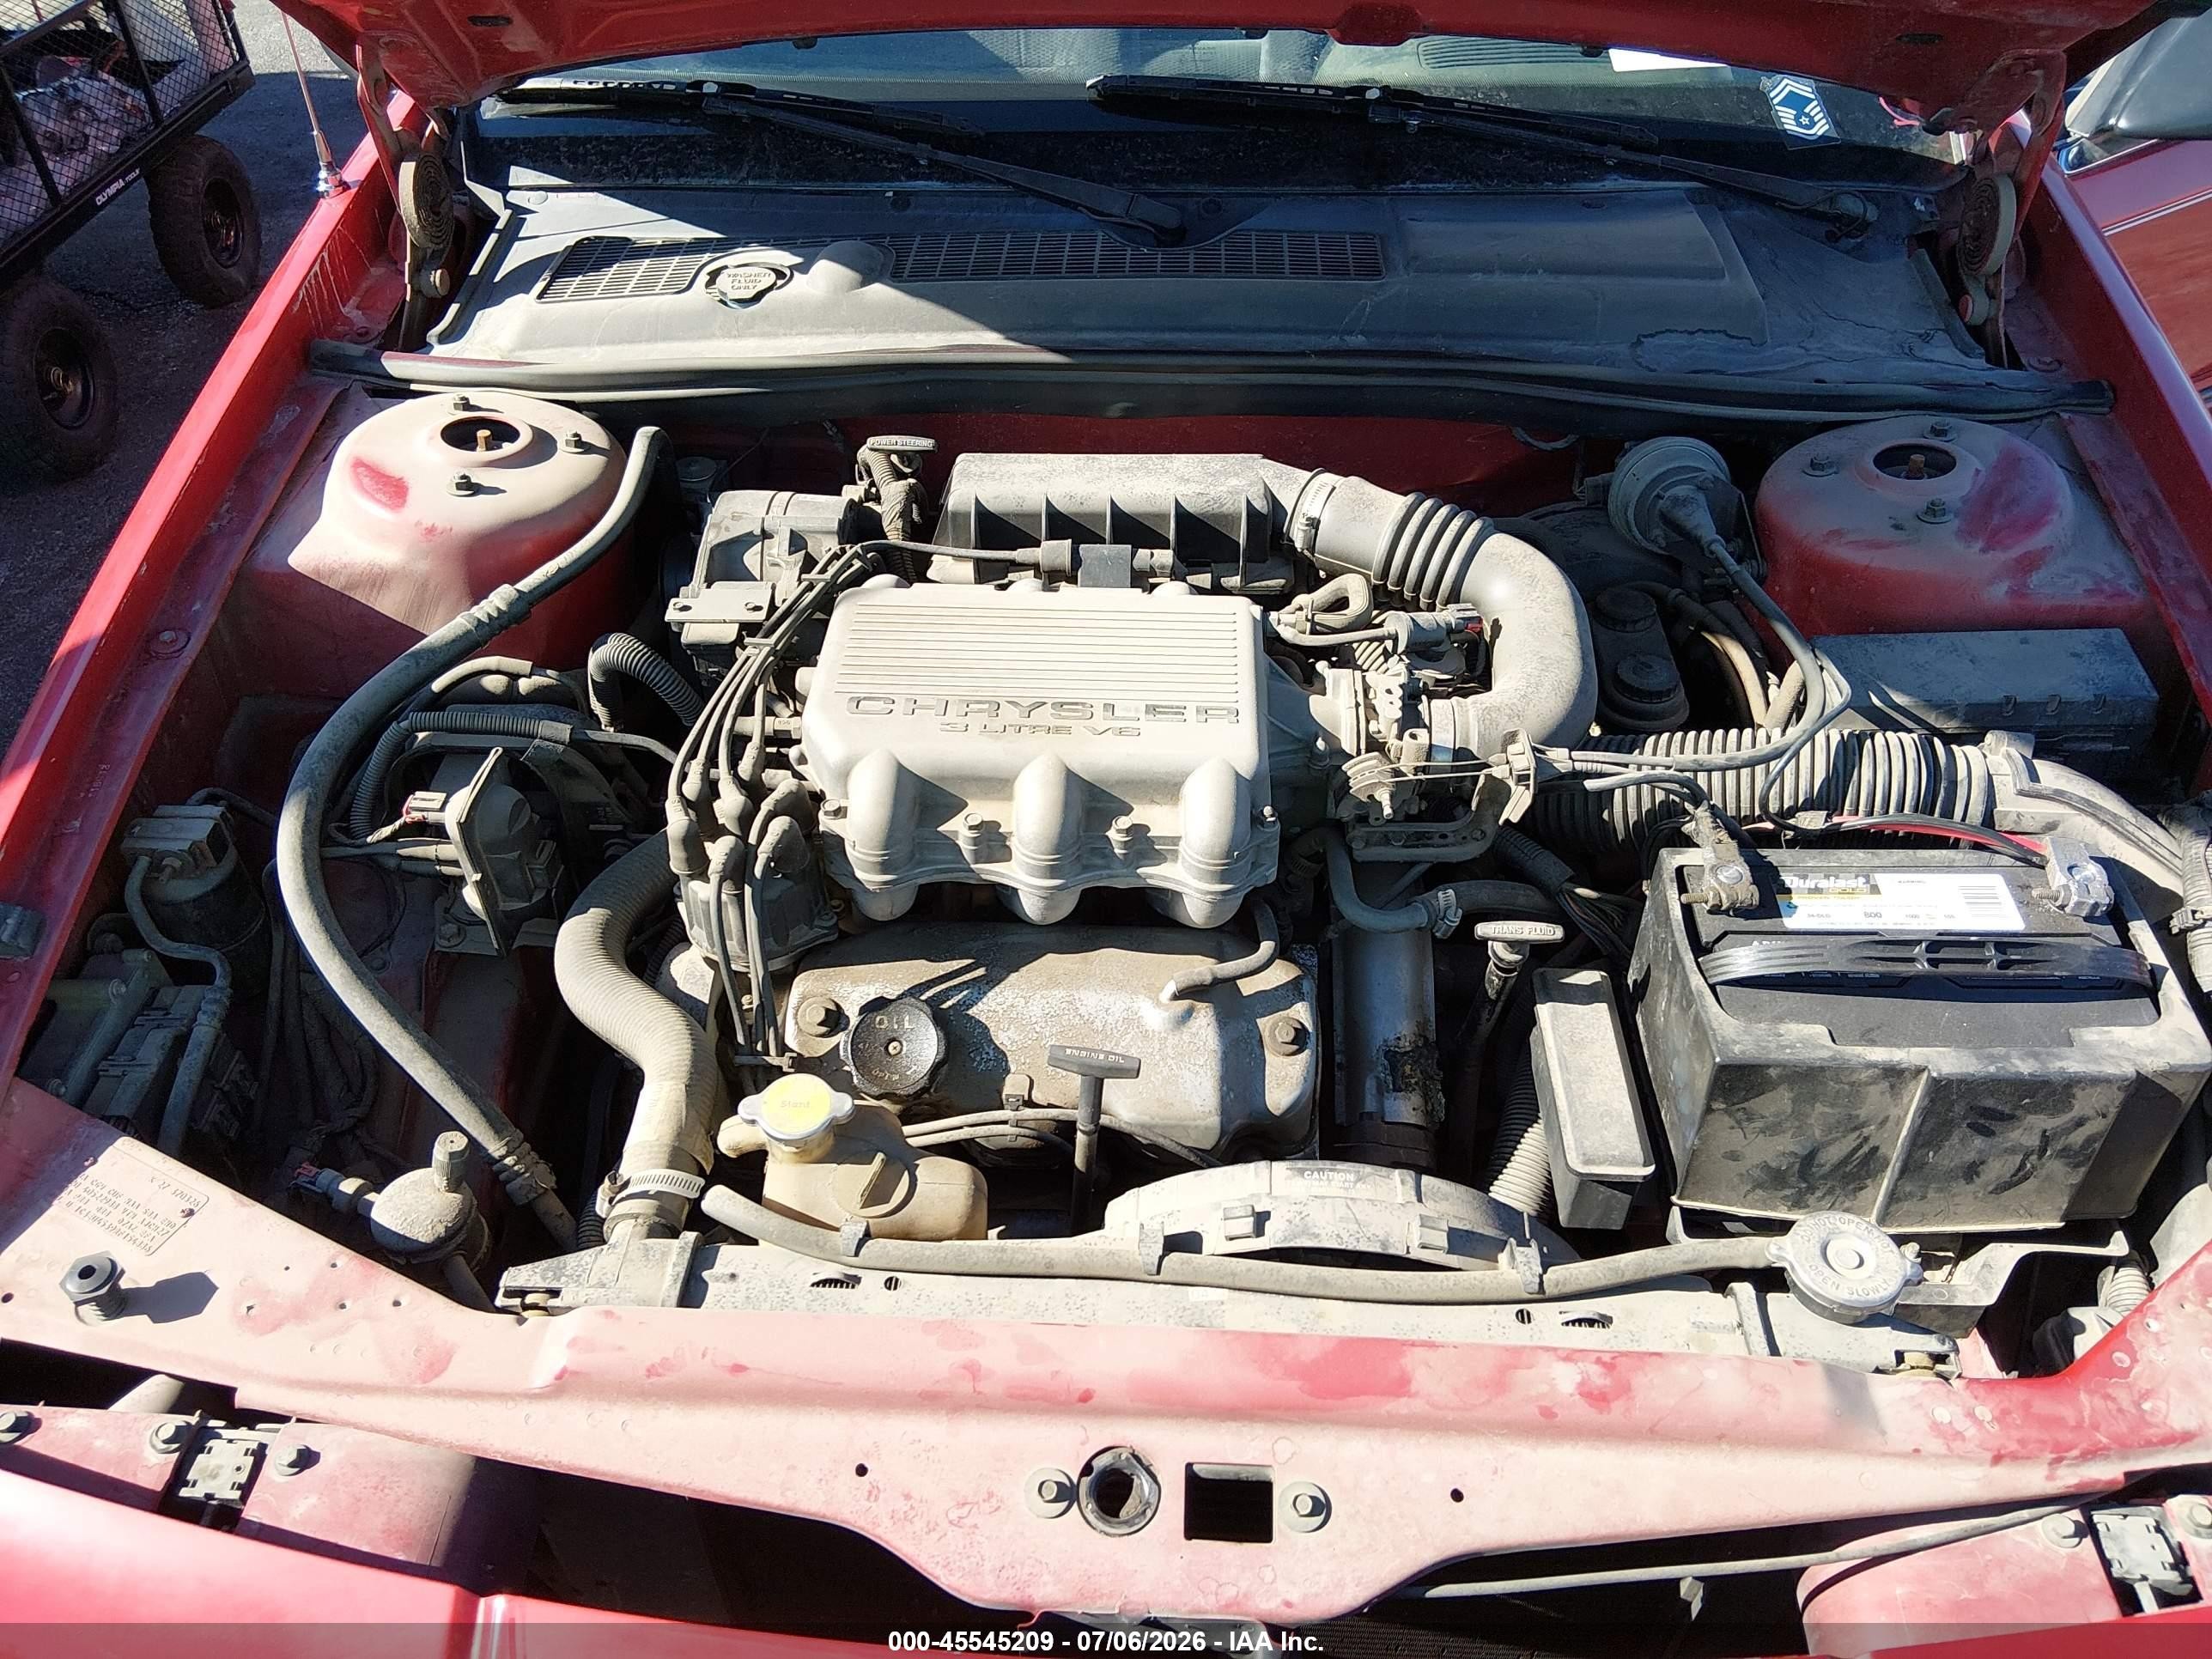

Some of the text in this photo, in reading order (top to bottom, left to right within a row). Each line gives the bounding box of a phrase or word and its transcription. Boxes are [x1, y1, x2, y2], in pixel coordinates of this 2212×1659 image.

[95, 178, 125, 206] OLYMPIA
[896, 439, 933, 447] STEERING
[846, 696, 1239, 724] CHRYSLER
[939, 721, 1141, 738] 3 LITRE V6
[1528, 927, 1555, 936] FLUID
[875, 1015, 914, 1029] OIL
[1065, 1048, 1125, 1063] ENGINE OIL
[780, 1100, 811, 1109] Stant
[1304, 1170, 1354, 1182] CAUTION
[1808, 1264, 1891, 1297] OPEN SLOWLY
